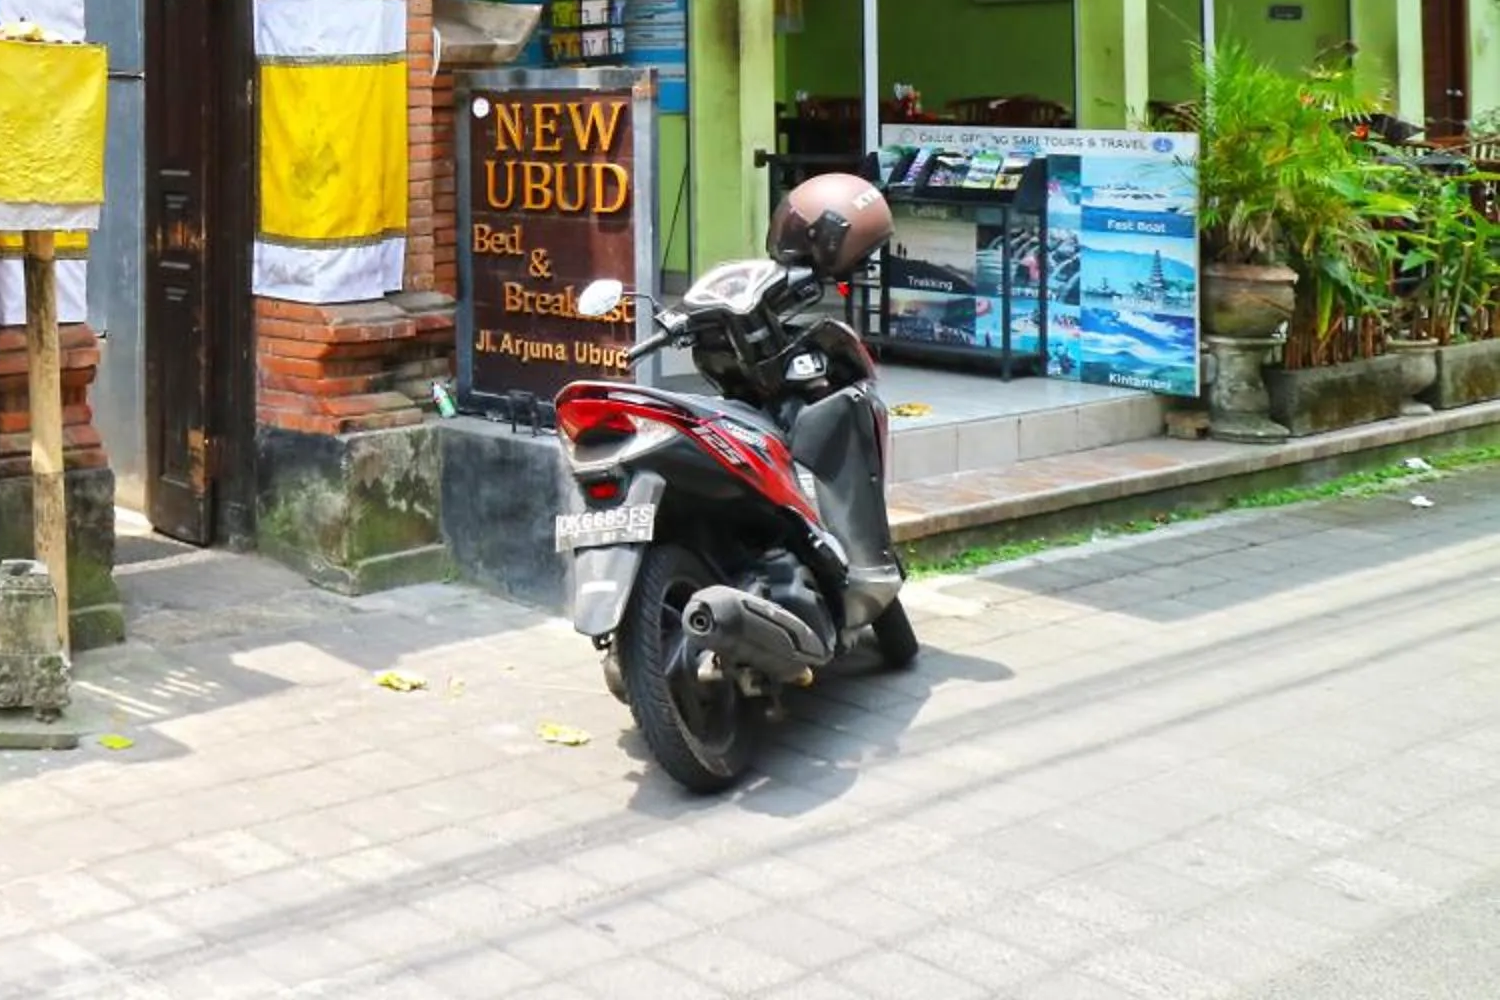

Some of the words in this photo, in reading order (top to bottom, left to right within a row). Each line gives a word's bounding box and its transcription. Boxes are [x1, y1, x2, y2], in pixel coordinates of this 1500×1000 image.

[495, 102, 627, 152] NEW
[1043, 136, 1084, 148] TOURS
[1100, 138, 1147, 151] TRAVEL
[485, 159, 630, 213] UBUD
[473, 223, 524, 256] Bed
[1107, 219, 1135, 231] Fast
[1137, 221, 1166, 233] Boat
[528, 247, 552, 278] &
[908, 275, 953, 291] Trekking
[499, 331, 566, 362] Arjuna
[1109, 373, 1172, 390] Kintamani
